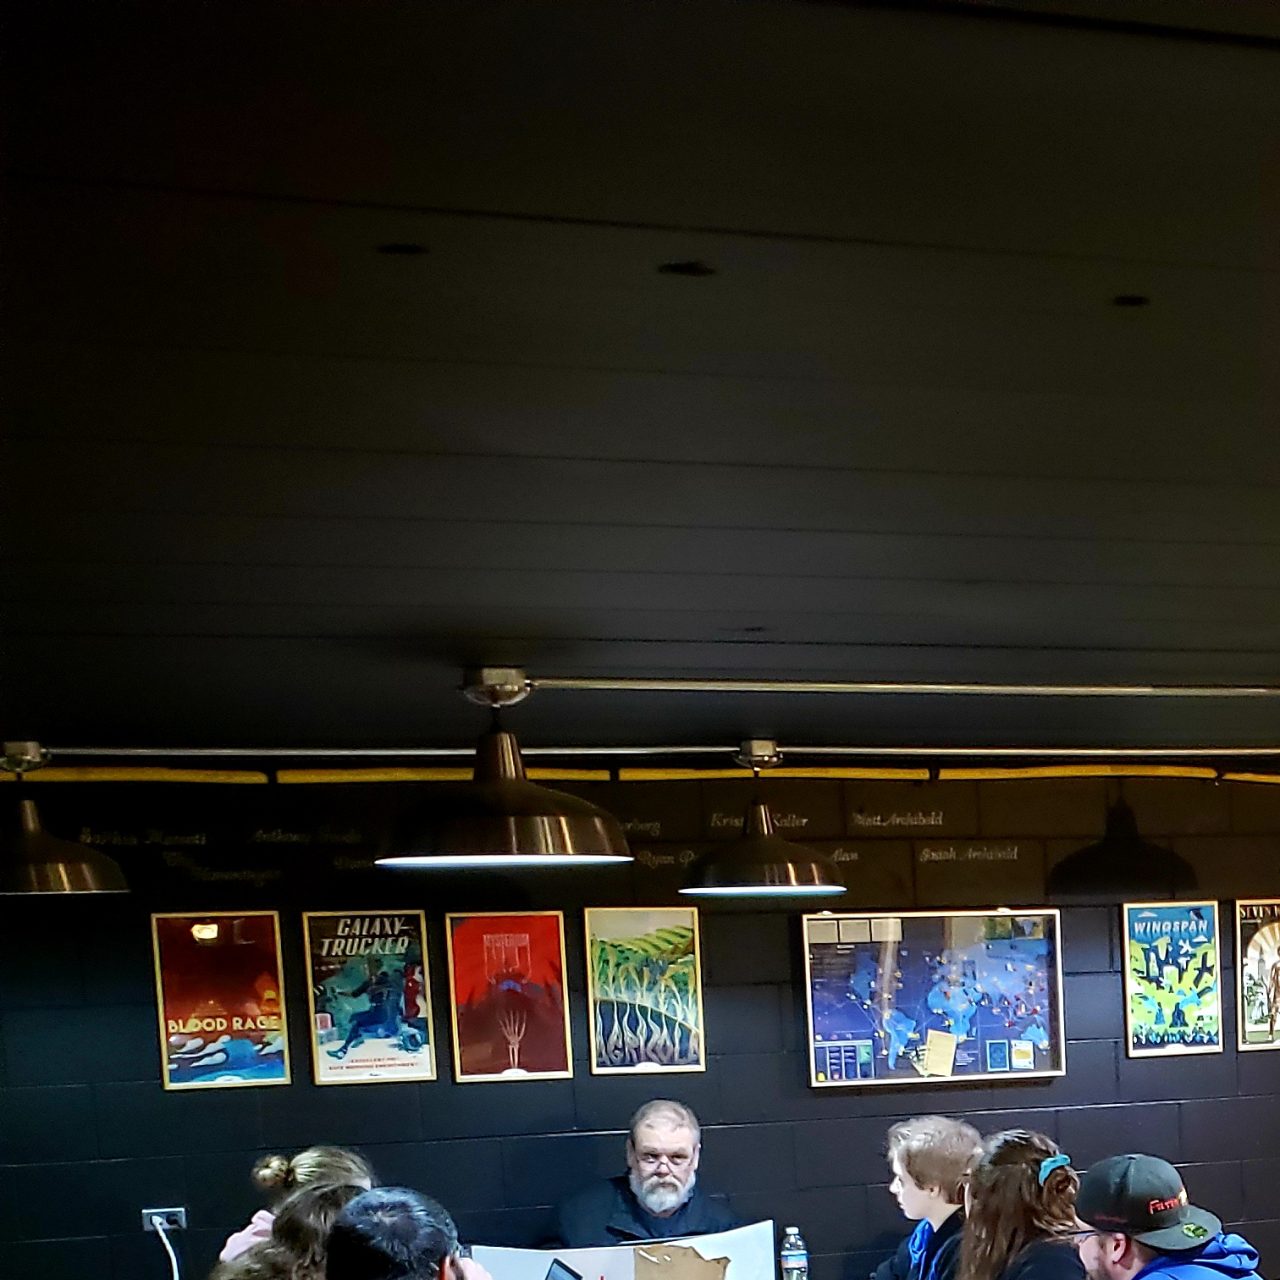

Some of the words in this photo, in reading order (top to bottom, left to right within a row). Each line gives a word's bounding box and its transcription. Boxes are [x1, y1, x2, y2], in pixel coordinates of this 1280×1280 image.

[1239, 905, 1271, 919] SEVEN
[337, 917, 412, 937] GALAXY
[1133, 919, 1208, 934] WINGSPAN
[320, 935, 410, 957] TRUCKER
[168, 1016, 228, 1034] BLOOD
[232, 1014, 280, 1031] RAGE
